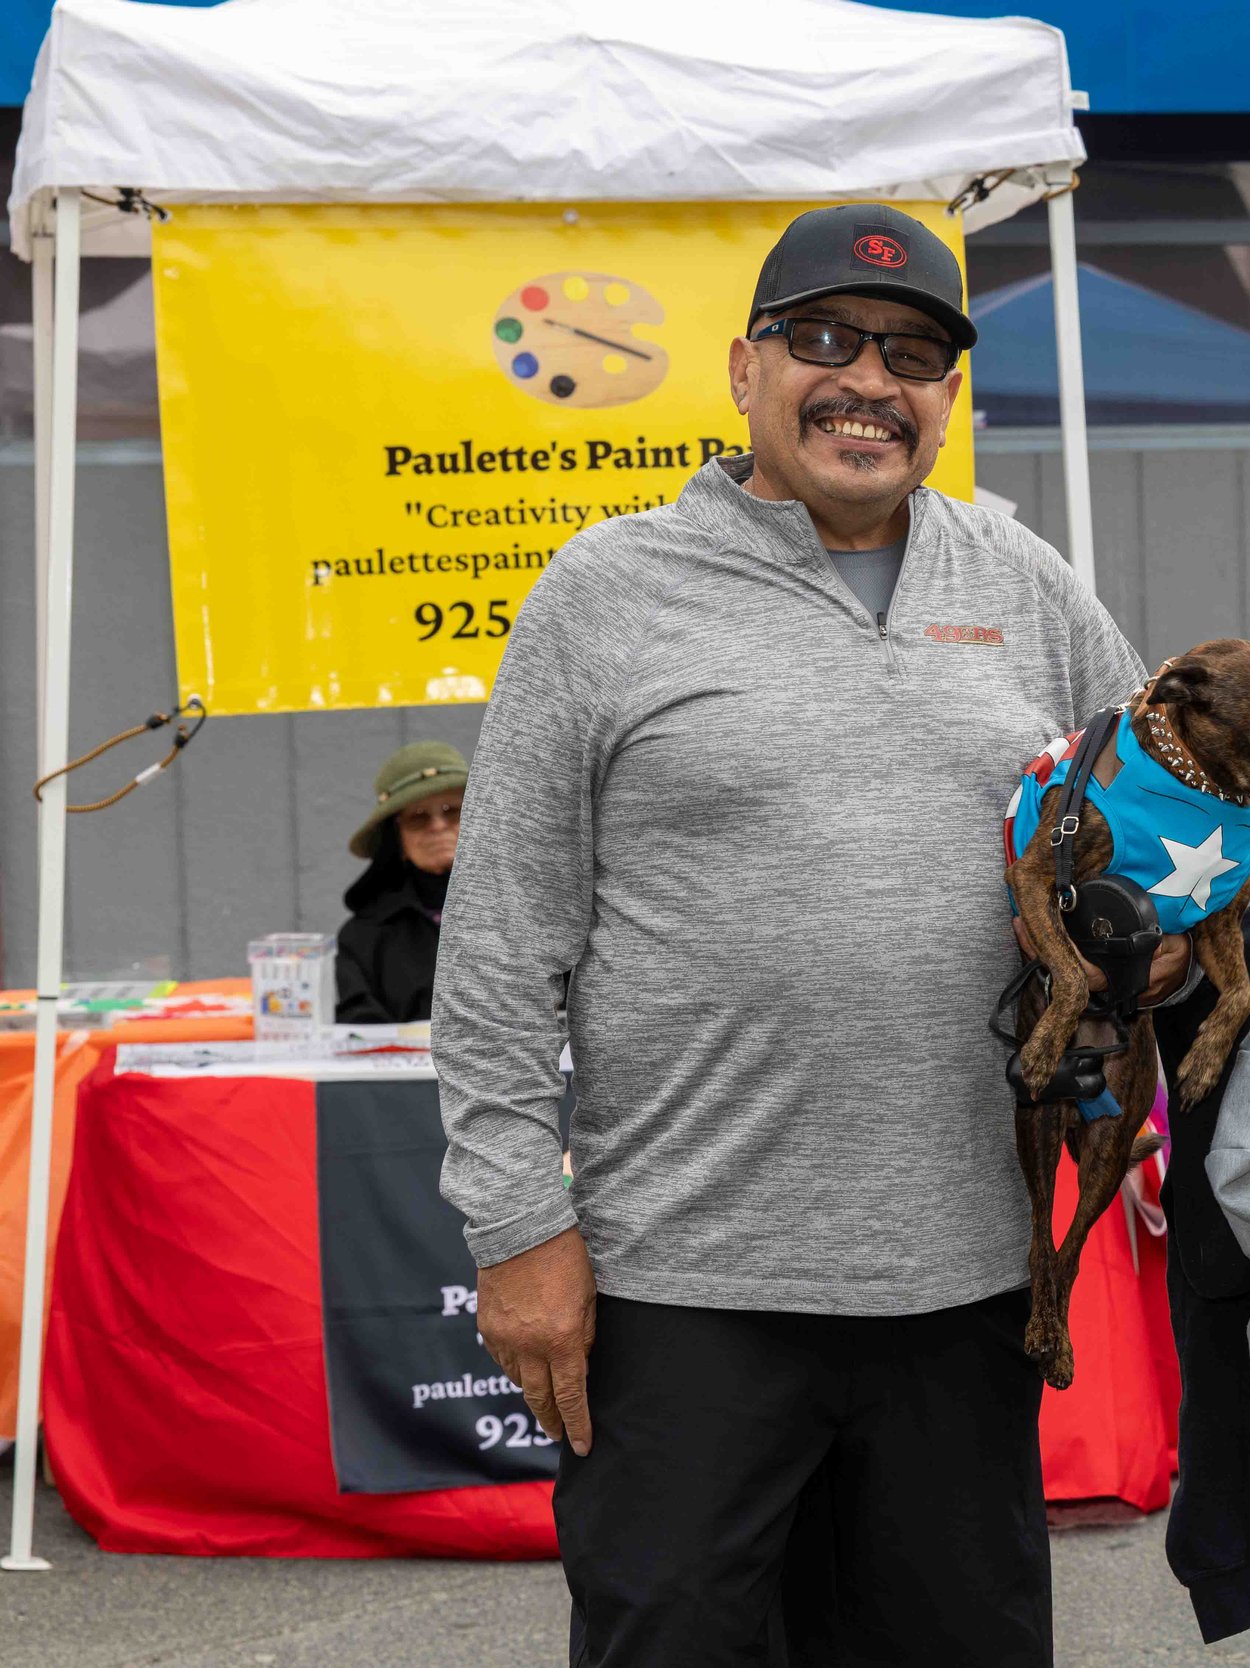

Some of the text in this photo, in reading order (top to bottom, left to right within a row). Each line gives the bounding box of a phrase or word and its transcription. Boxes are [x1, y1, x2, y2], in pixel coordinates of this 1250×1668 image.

[867, 239, 896, 261] SF
[384, 437, 753, 476] Paulette's Paint Pa
[405, 494, 665, 530] "Creativity wit
[414, 598, 512, 642] 925
[923, 623, 1004, 644] 49ERS
